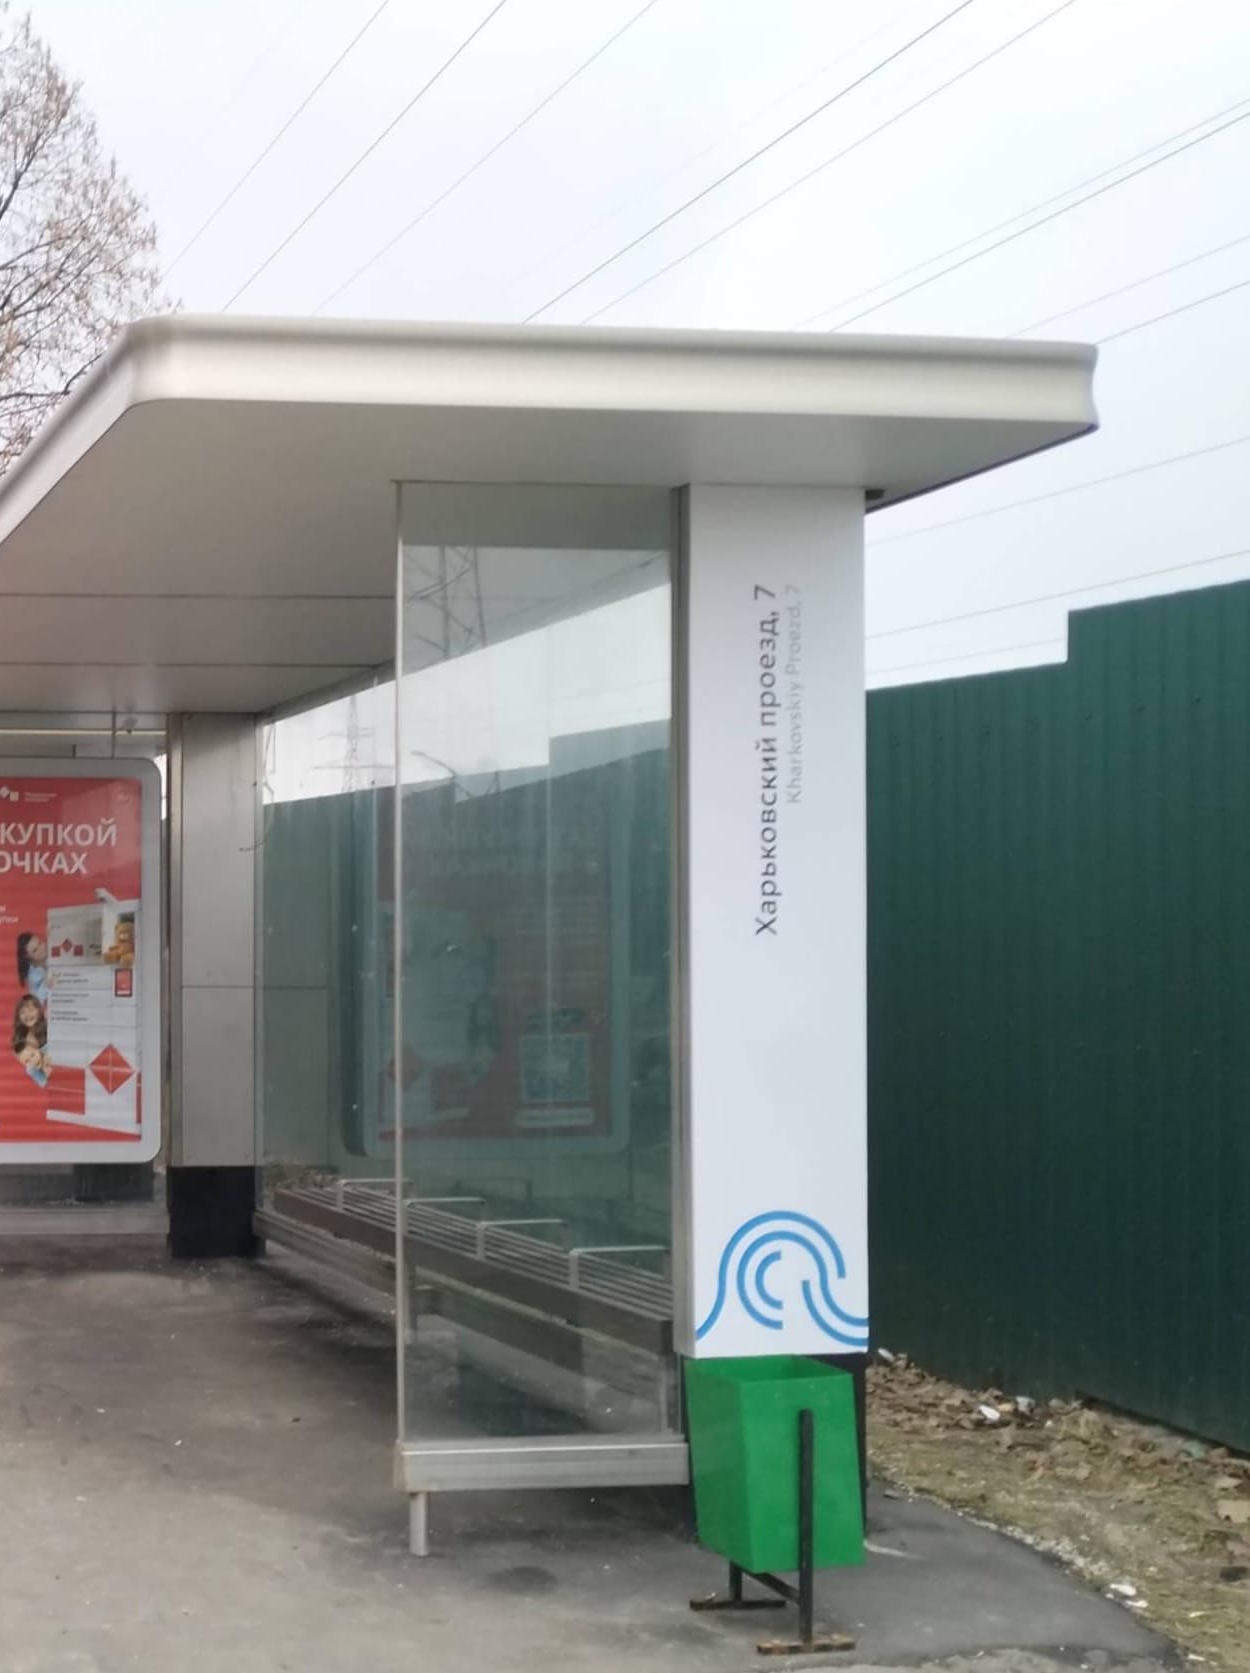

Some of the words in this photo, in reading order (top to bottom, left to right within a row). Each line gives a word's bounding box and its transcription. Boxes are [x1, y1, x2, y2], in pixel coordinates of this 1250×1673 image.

[754, 583, 777, 601] 7
[758, 611, 781, 726] проезд,
[785, 684, 805, 804] Kharkovskiy
[755, 737, 782, 936] Харьковский
